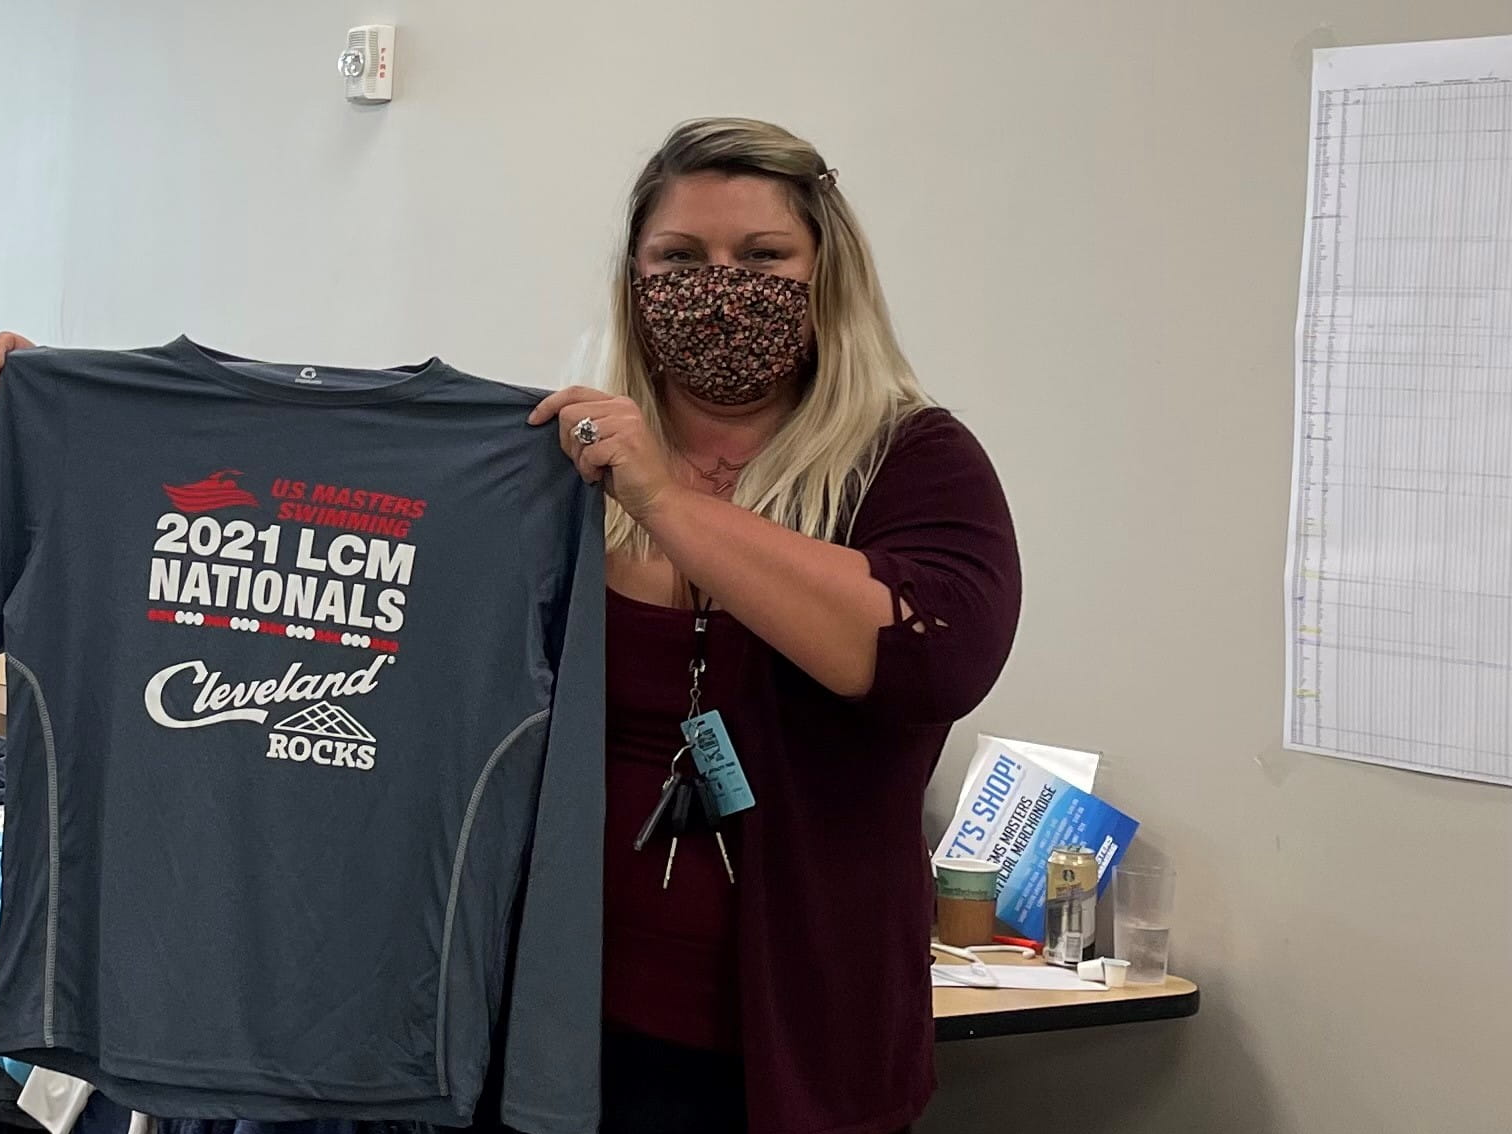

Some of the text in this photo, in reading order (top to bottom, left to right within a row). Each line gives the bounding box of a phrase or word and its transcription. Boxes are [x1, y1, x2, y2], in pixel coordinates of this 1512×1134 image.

[379, 47, 387, 79] FIRE
[277, 502, 411, 539] SWIMMING
[312, 483, 427, 519] MASTERS
[153, 512, 416, 585] 2021 LCM
[148, 557, 406, 632] NATIONALS
[144, 654, 389, 729] Cleveland
[266, 732, 377, 770] ROCKS
[972, 754, 1022, 823] SHOP!
[1000, 795, 1033, 850] MASTERS
[1014, 783, 1057, 858] MERCHANDISE
